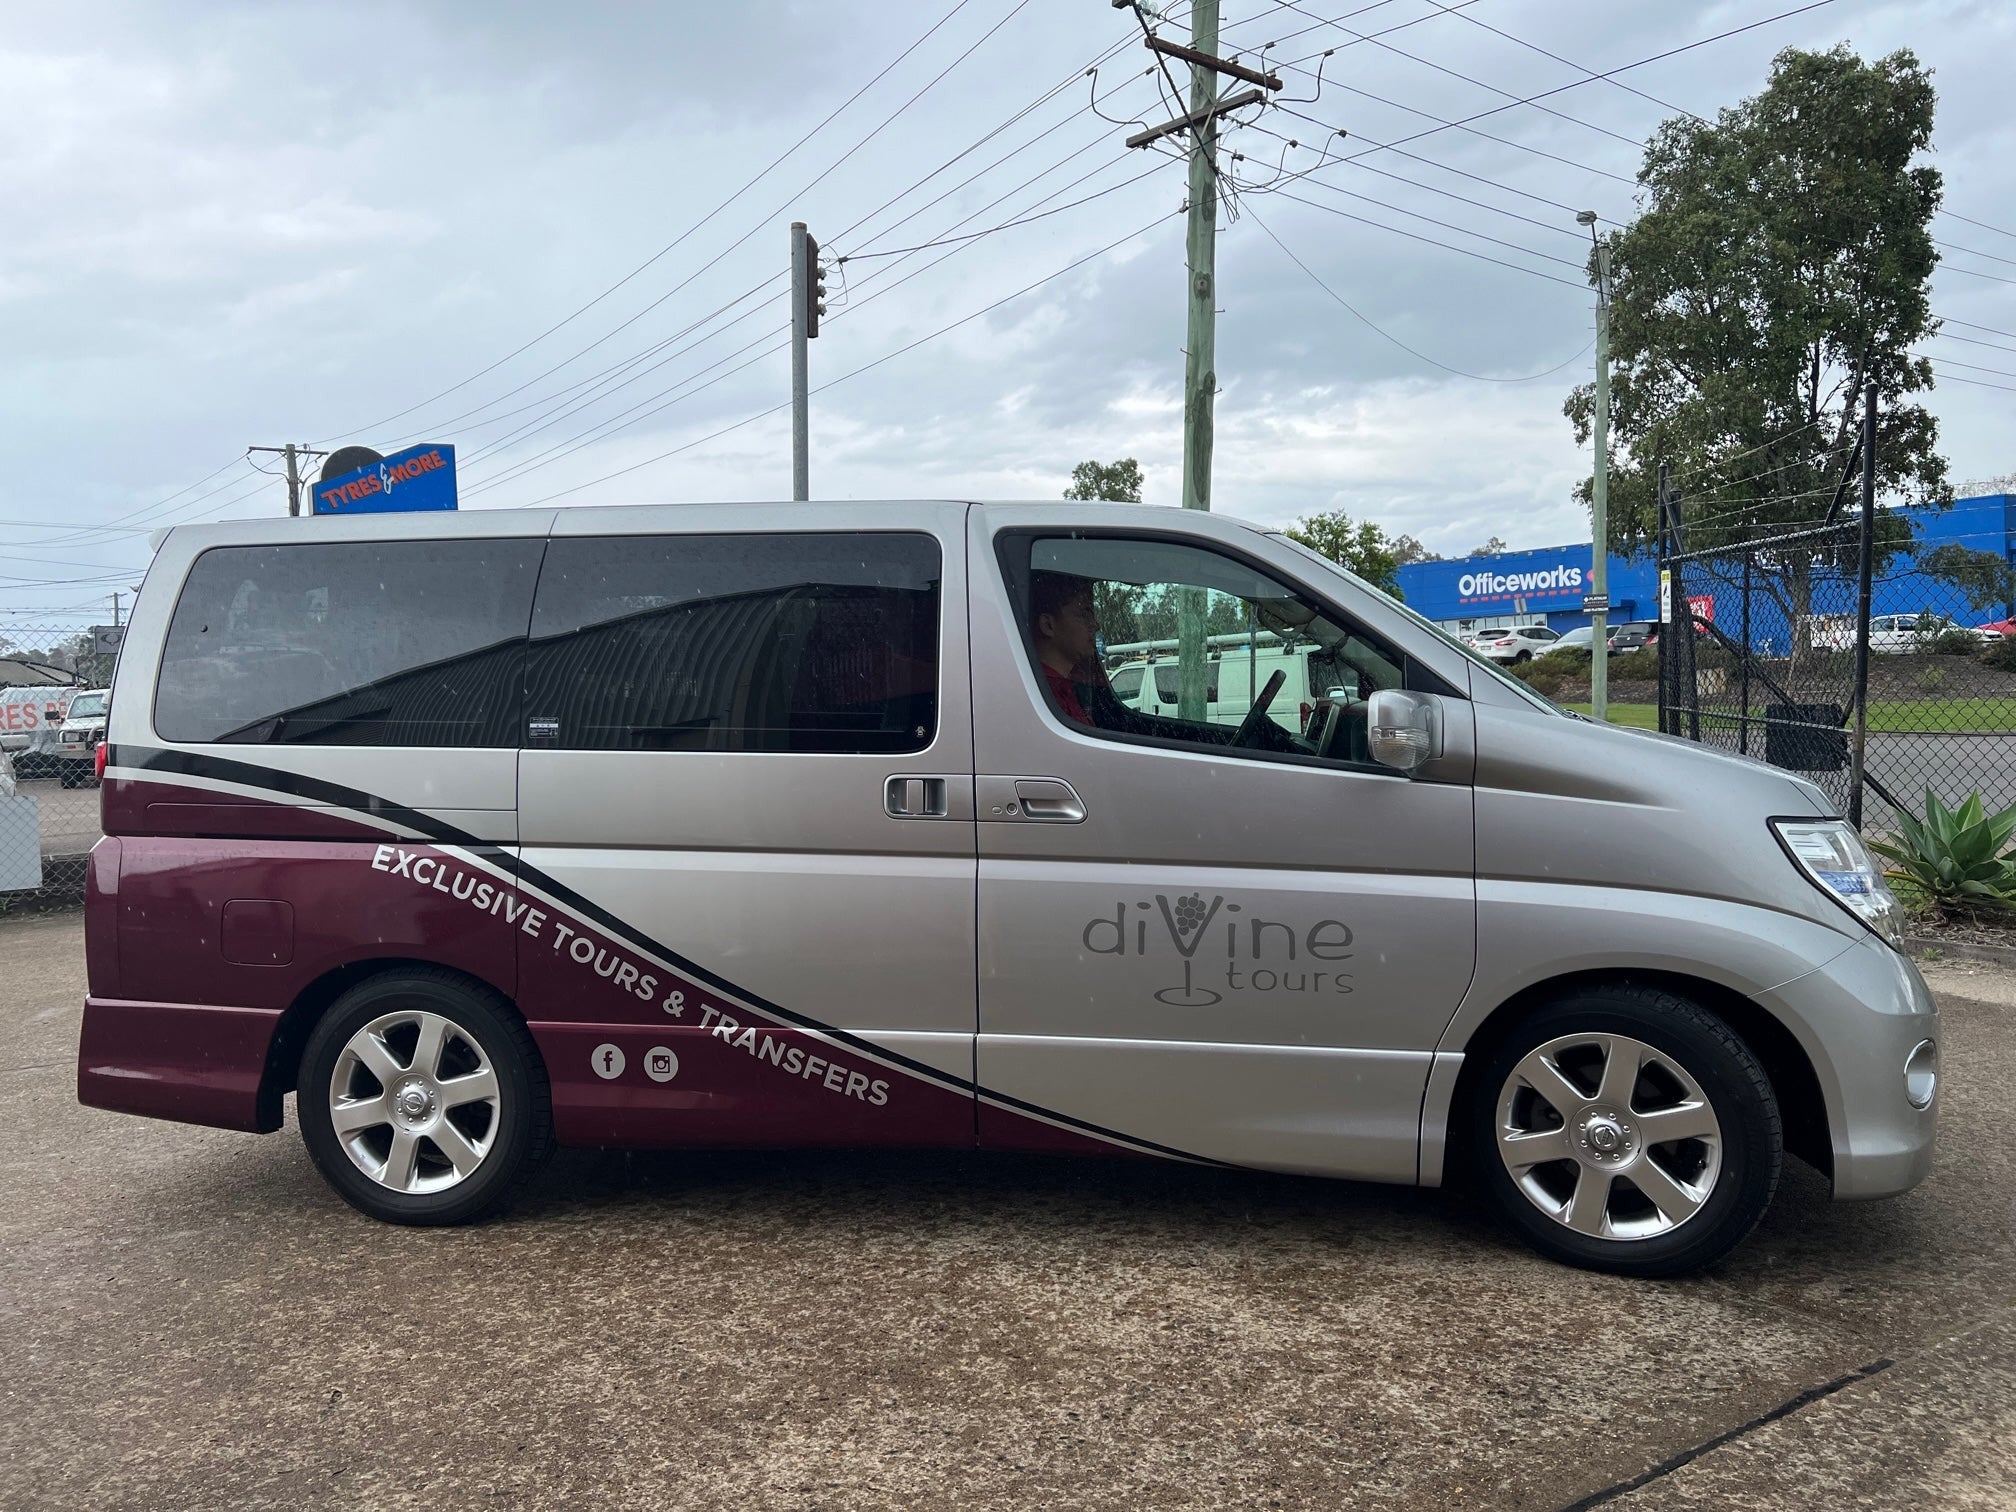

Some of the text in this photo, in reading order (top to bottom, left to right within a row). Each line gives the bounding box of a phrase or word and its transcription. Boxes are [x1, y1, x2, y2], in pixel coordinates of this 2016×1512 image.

[321, 450, 447, 508] TYRES & MORE
[1459, 565, 1582, 596] Officeworks
[371, 844, 890, 1106] EXCLUSIVE TOURS & TRANSFERS
[1225, 961, 1354, 994] tours
